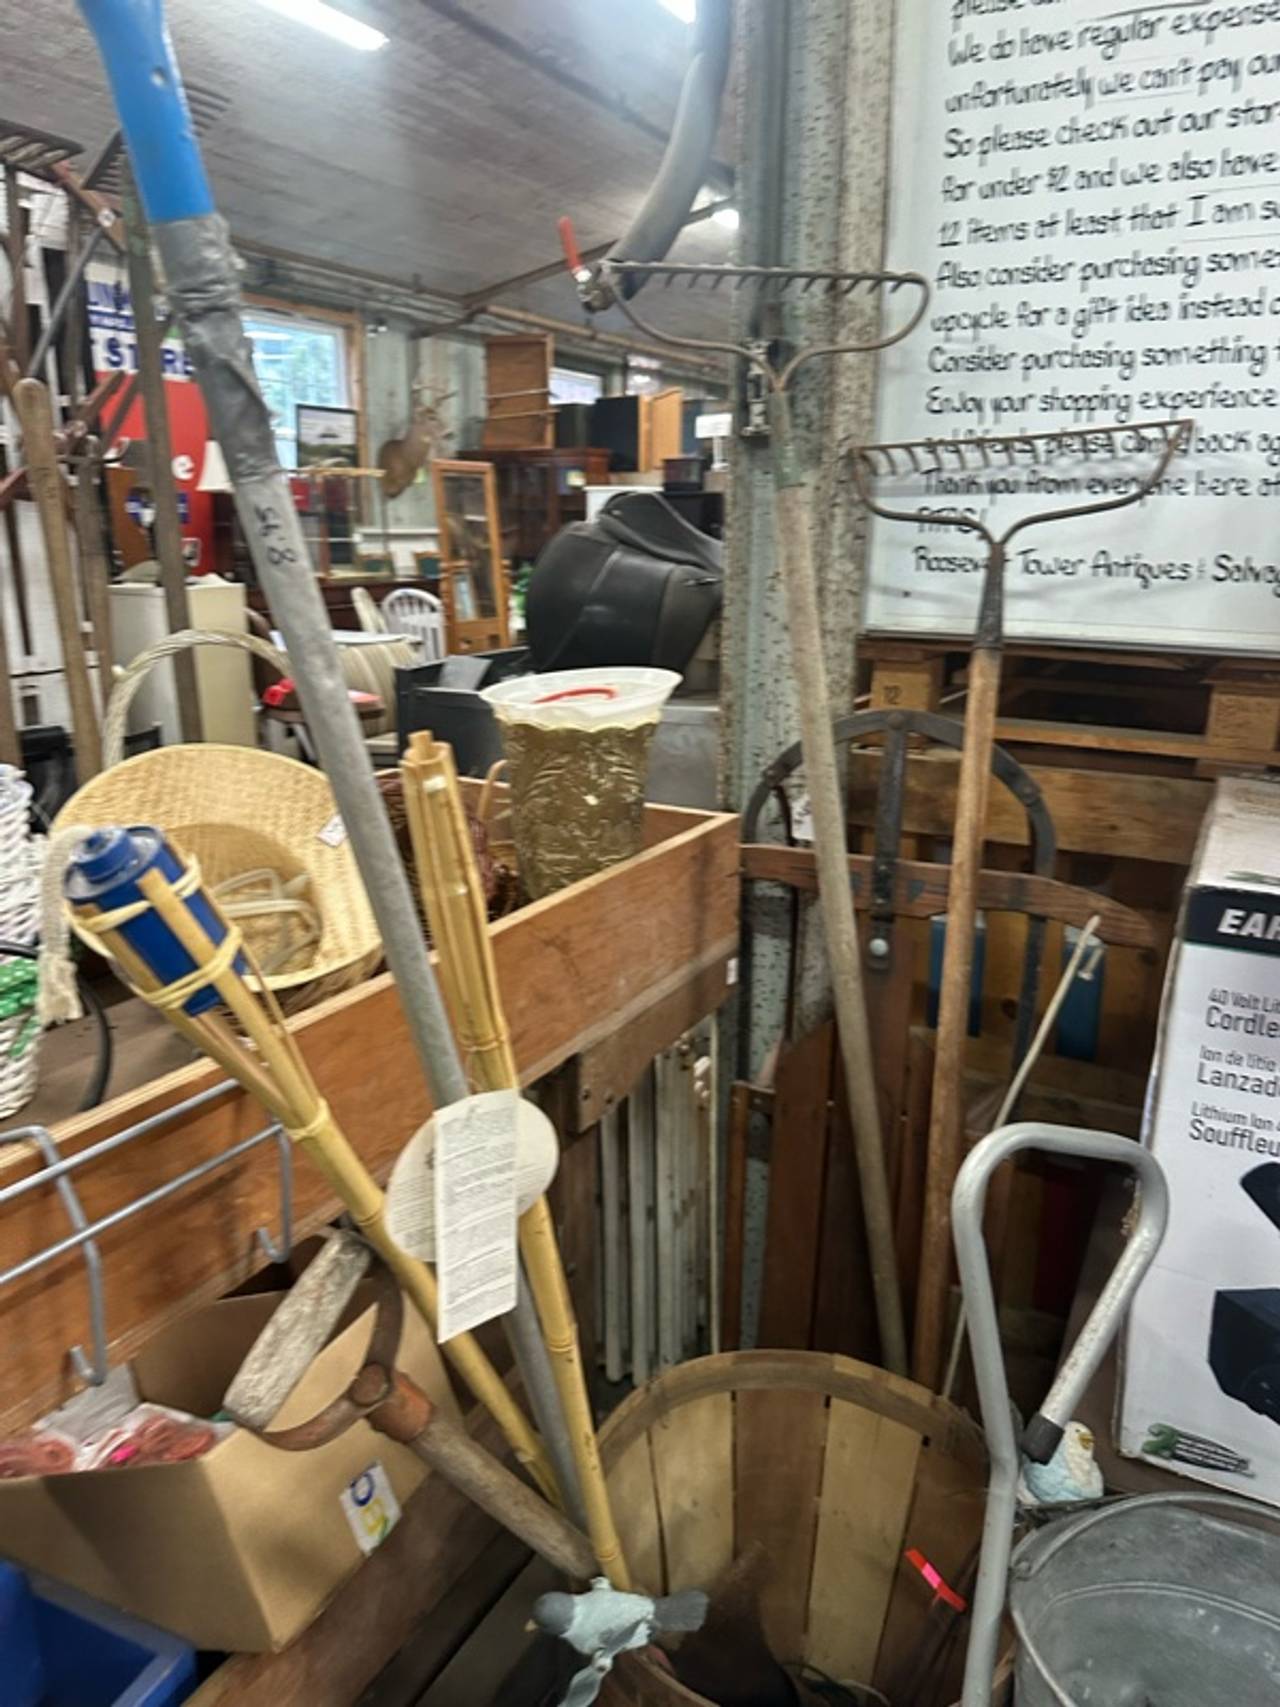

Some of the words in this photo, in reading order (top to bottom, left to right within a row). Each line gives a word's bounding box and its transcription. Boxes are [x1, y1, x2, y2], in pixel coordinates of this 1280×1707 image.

[947, 32, 985, 66] We
[988, 28, 1017, 60] do
[1019, 27, 1074, 57] have
[1076, 12, 1168, 61] regular
[945, 66, 1096, 113] unfortunately
[1097, 71, 1135, 96] we
[1197, 57, 1244, 97] pay
[943, 127, 975, 159] So
[976, 123, 1052, 168] please
[1054, 114, 1130, 146] check
[1132, 106, 1176, 138] out
[1178, 106, 1223, 133] our
[941, 174, 977, 203] for
[978, 165, 1043, 200] under
[1073, 156, 1119, 191] and
[1120, 162, 1163, 186] we
[1167, 149, 1218, 183] also
[1219, 147, 1279, 178] have
[966, 217, 1031, 245] items
[1033, 212, 1062, 239] at
[1127, 201, 1181, 232] that
[1183, 193, 1210, 228] I
[1211, 201, 1257, 224] am
[934, 259, 982, 290] Also
[984, 254, 1077, 287] consider
[1078, 245, 1202, 293] purchasing
[929, 301, 1011, 343] upcycle
[1015, 300, 1053, 328] for
[1054, 306, 1070, 327] a
[1070, 295, 1124, 341] gift
[1125, 292, 1174, 323] idea
[1176, 285, 1268, 322] instead
[927, 344, 1019, 375] Consider
[1020, 339, 1138, 383] purchasing
[1140, 333, 1270, 378] something
[987, 392, 1036, 427] your
[1038, 384, 1134, 424] shopping
[1137, 380, 1278, 421] experience
[1193, 425, 1251, 455] back
[919, 467, 982, 496] Thank
[985, 475, 1025, 507] you
[1026, 467, 1082, 495] from
[1194, 469, 1251, 497] here
[1014, 548, 1086, 577] Tower
[1089, 549, 1194, 590] Antiques
[1207, 987, 1229, 1007] 40
[1230, 991, 1261, 1011] Volt
[1199, 1045, 1223, 1063] Ion
[1224, 1050, 1244, 1068] de
[1191, 1101, 1249, 1127] Lithium
[1250, 1112, 1274, 1132] Ion
